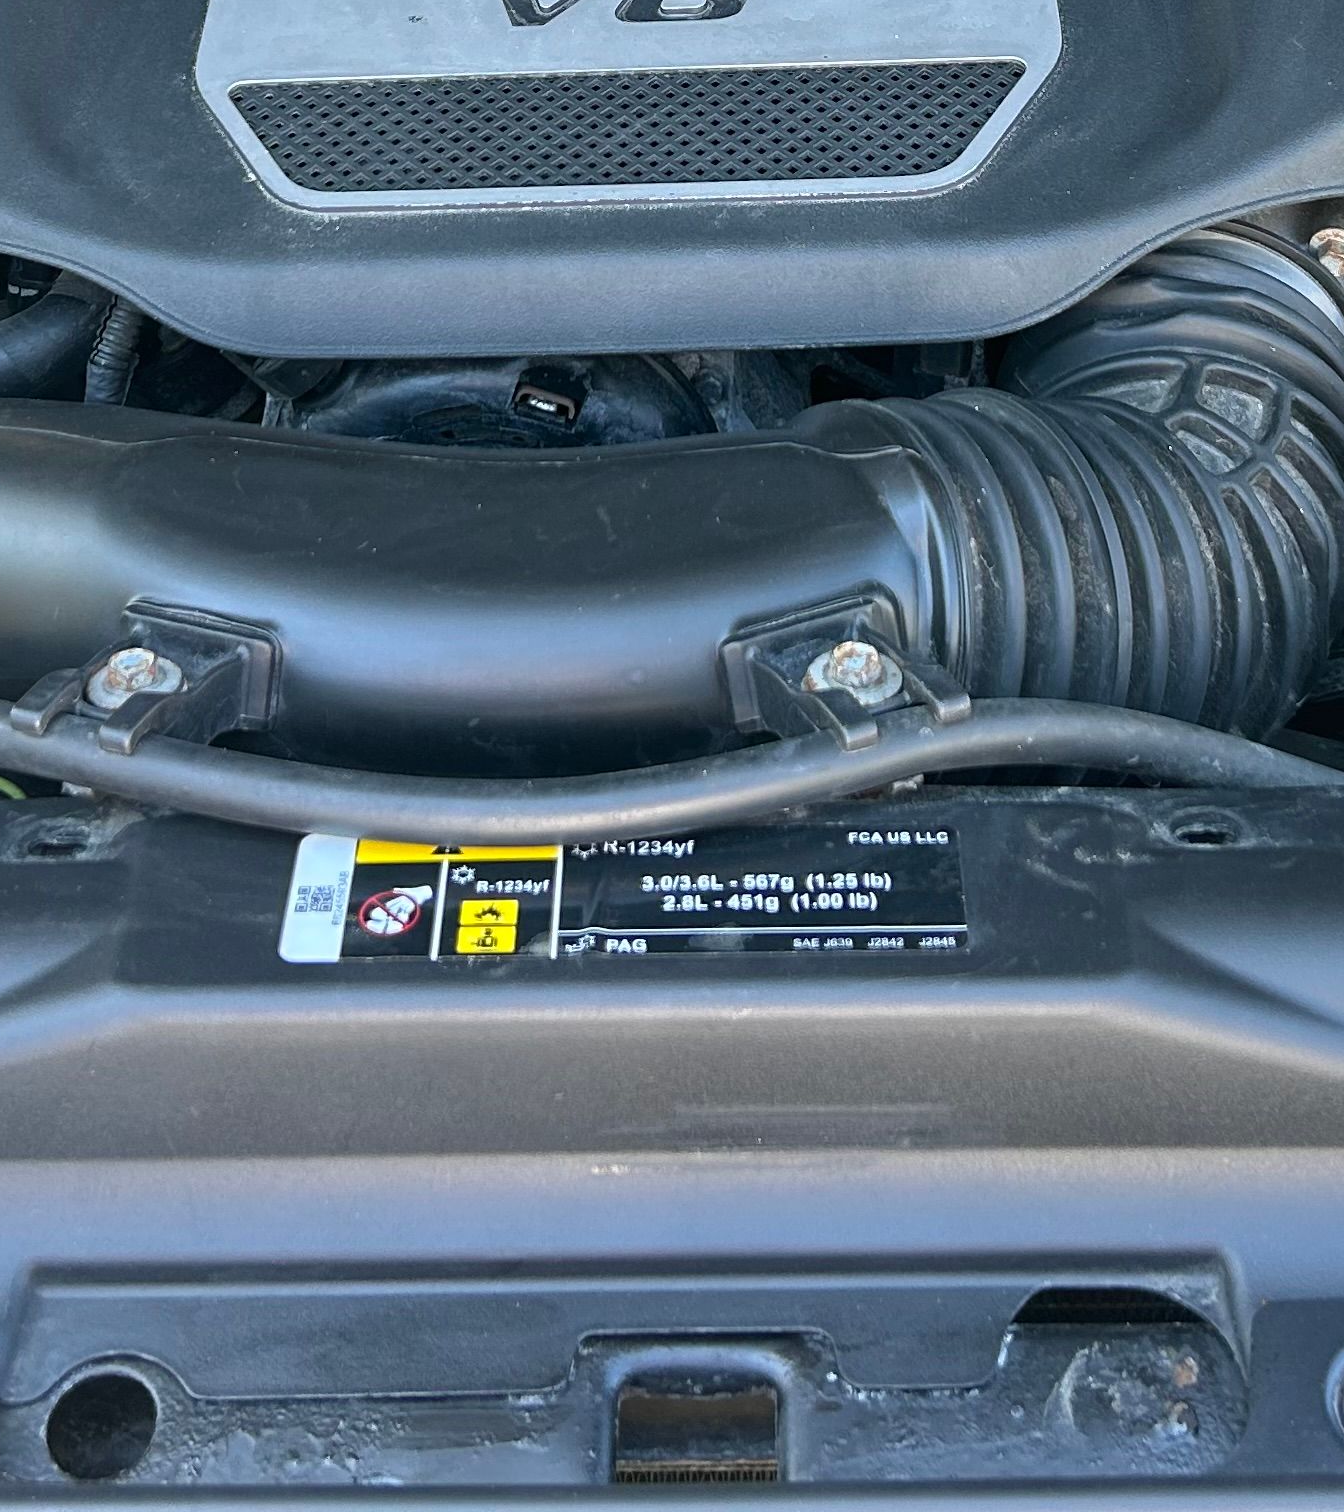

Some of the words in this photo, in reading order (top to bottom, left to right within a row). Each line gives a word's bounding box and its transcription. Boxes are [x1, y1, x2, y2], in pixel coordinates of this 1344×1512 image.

[848, 831, 884, 846] FCA
[887, 831, 912, 845] US
[915, 831, 950, 845] LLC
[603, 839, 695, 859] R-1234yf
[476, 879, 551, 896] R-1234yf
[641, 874, 724, 892] 3.0/3.6L
[742, 873, 794, 893] 567g
[806, 872, 859, 893] (1.25
[863, 872, 893, 893] lb)
[662, 894, 708, 912] 2.8L
[726, 893, 780, 914] 451g
[790, 892, 844, 913] (1.00
[848, 892, 879, 913] lb)
[605, 938, 648, 954] PAG
[792, 937, 821, 950] SAE
